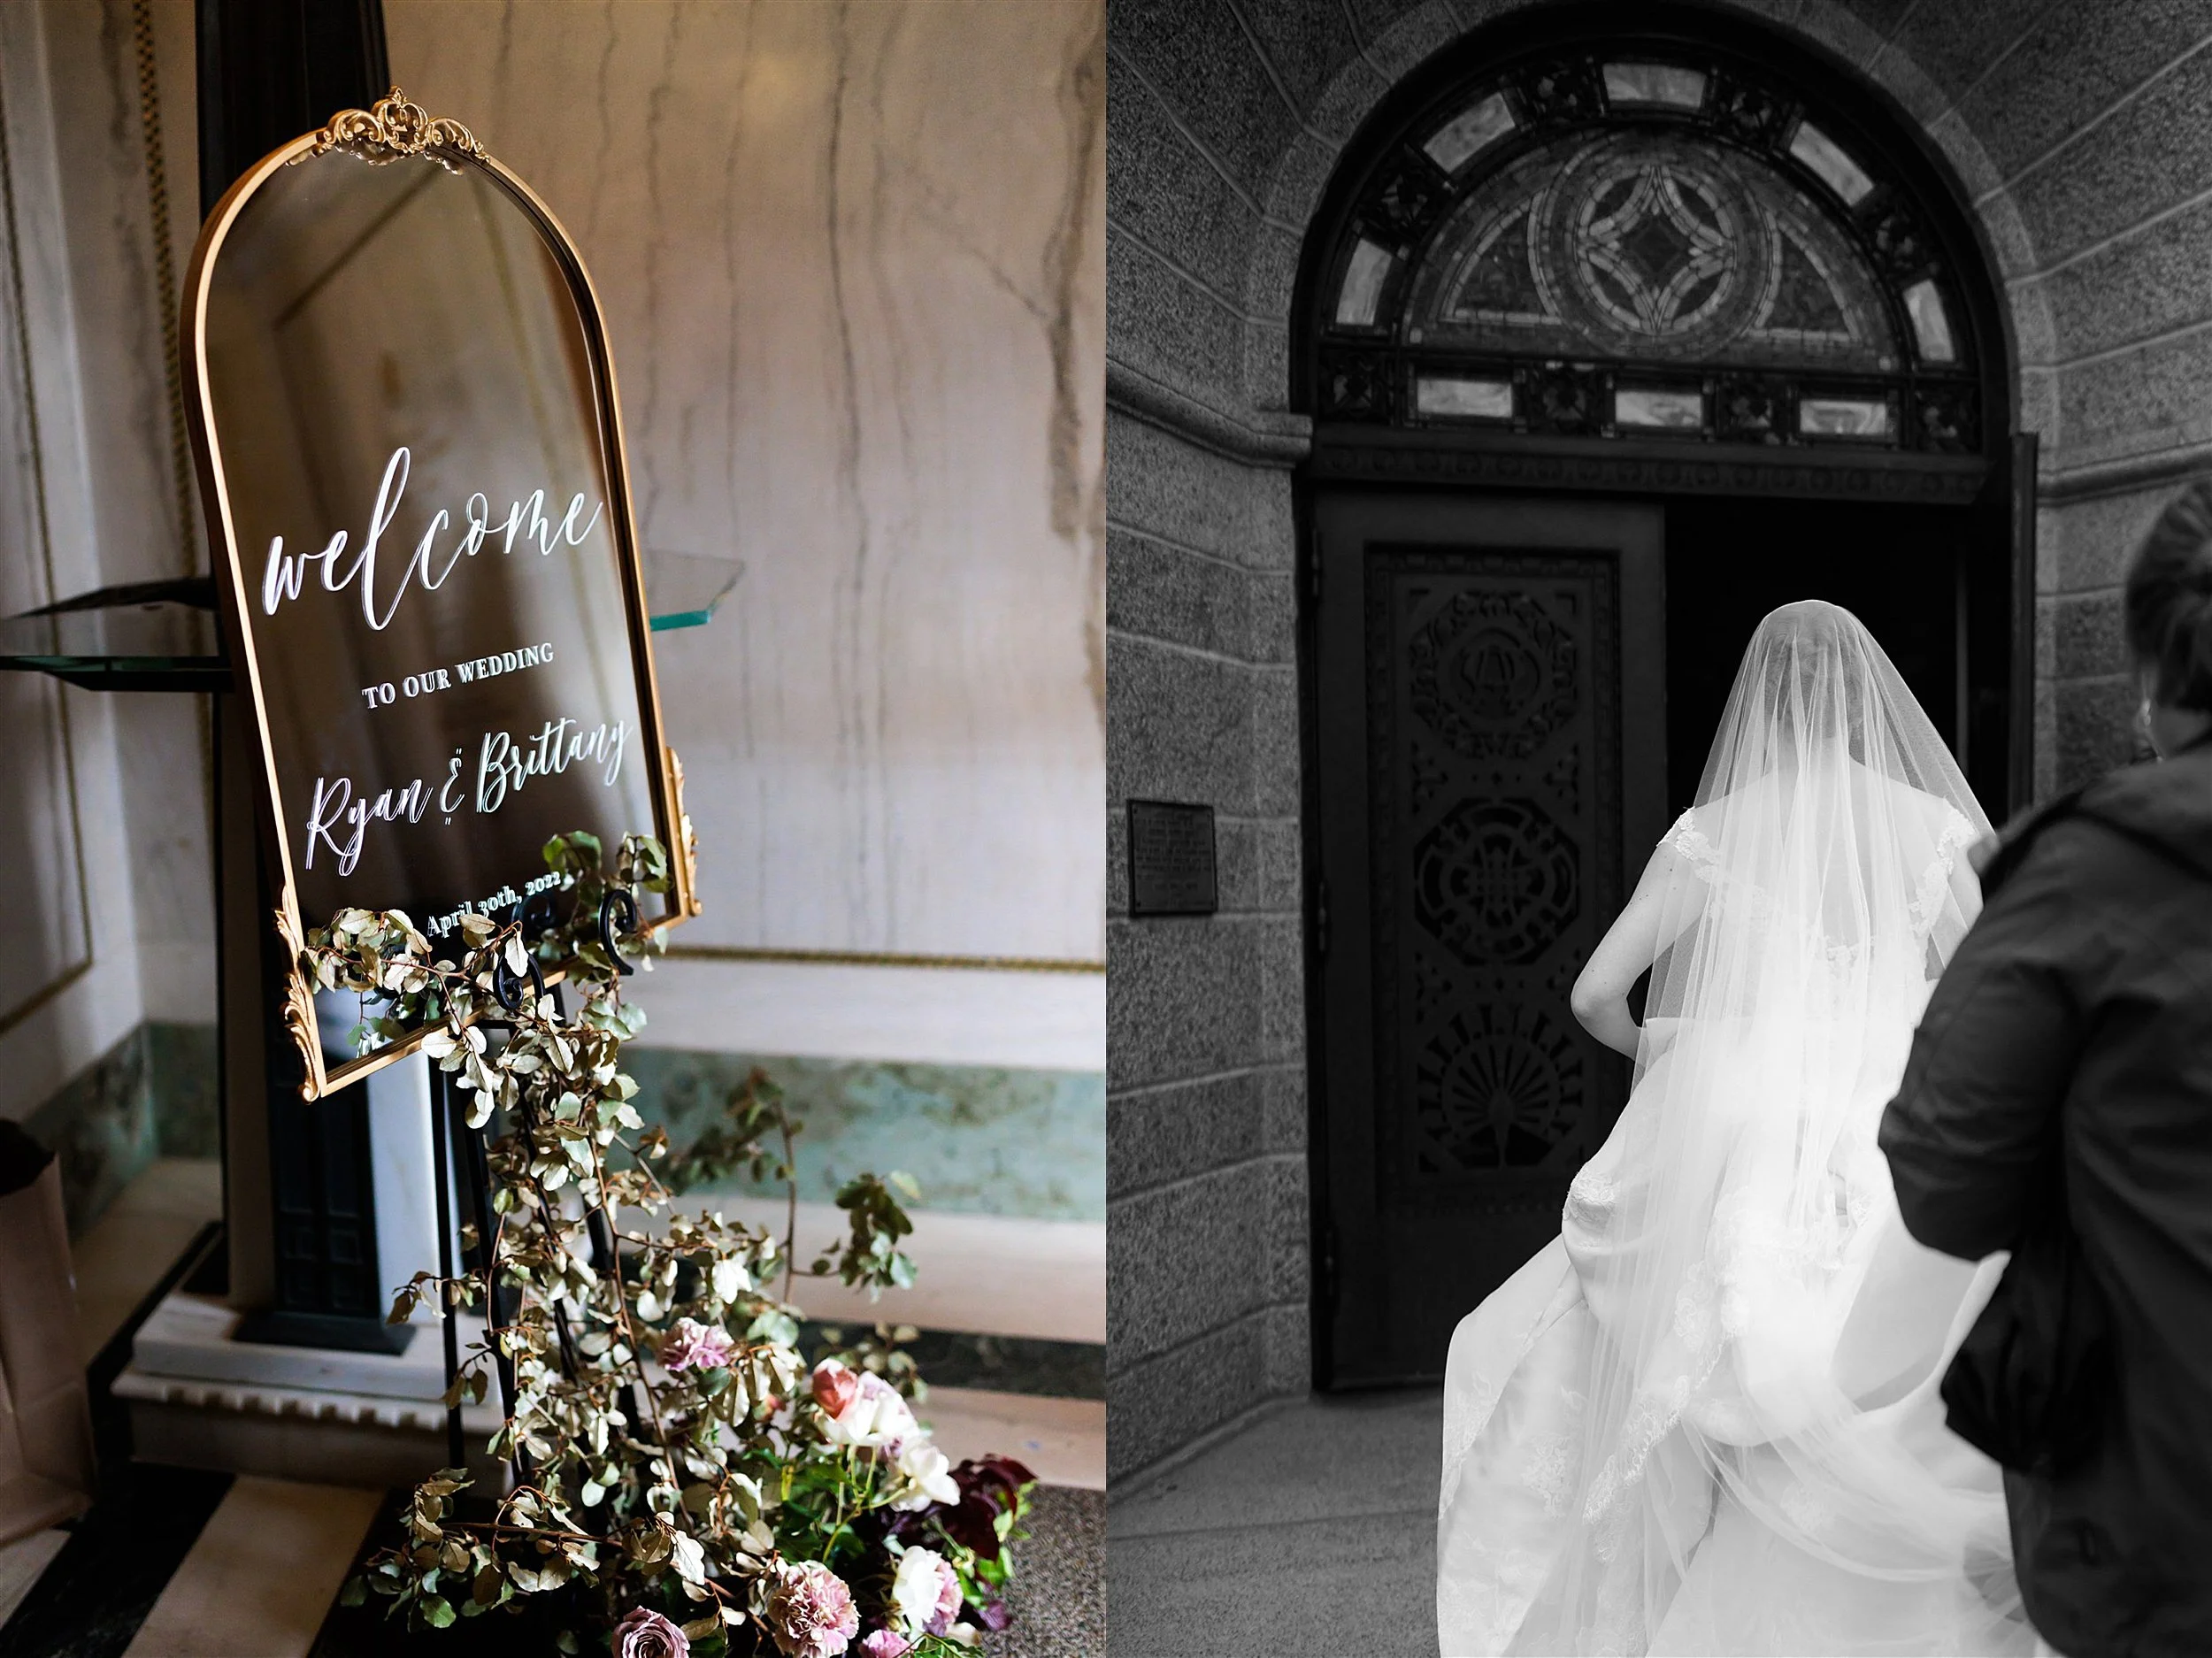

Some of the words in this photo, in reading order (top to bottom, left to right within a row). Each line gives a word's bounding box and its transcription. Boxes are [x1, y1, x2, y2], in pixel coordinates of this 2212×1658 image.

[262, 447, 603, 630] welcome
[361, 682, 396, 709] TO
[402, 668, 451, 697] OUR
[455, 642, 554, 684] WEDDING
[305, 777, 434, 876] Ryan
[476, 718, 633, 813] Brittany
[426, 901, 473, 939] April
[478, 886, 523, 917] 30th,
[525, 871, 561, 896] 2022
